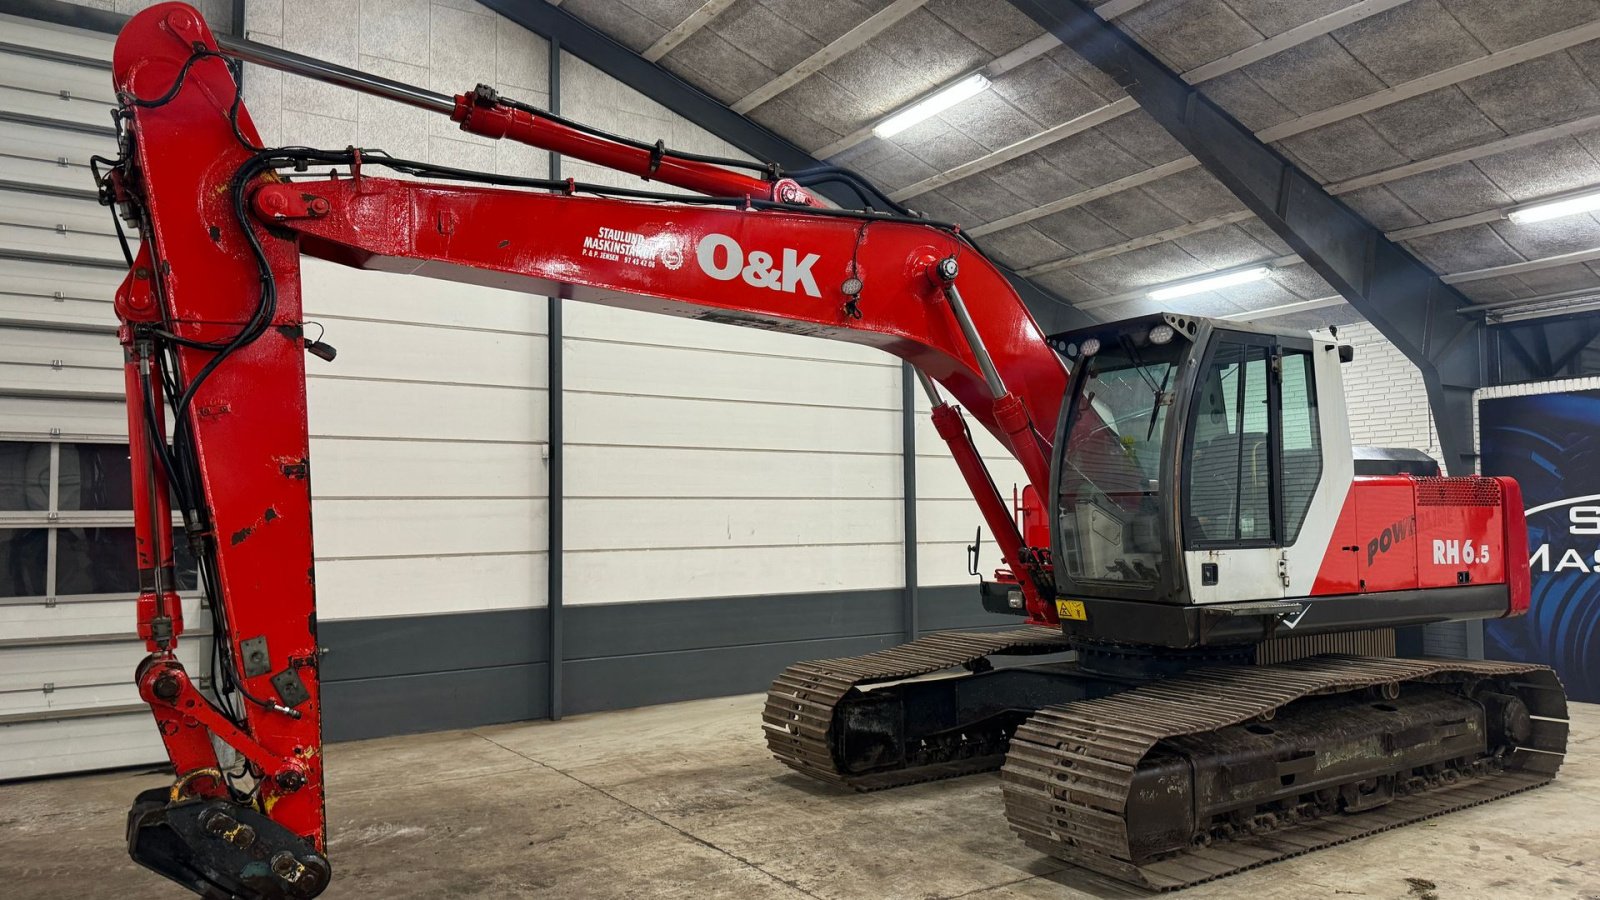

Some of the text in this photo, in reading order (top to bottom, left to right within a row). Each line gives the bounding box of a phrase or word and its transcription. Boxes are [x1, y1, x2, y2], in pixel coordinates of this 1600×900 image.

[583, 236, 656, 260] MASKINSTAON
[598, 226, 645, 246] STAULUND
[600, 252, 619, 262] JENSEN
[697, 233, 822, 298] O&K
[1433, 540, 1490, 565] RH 6.5
